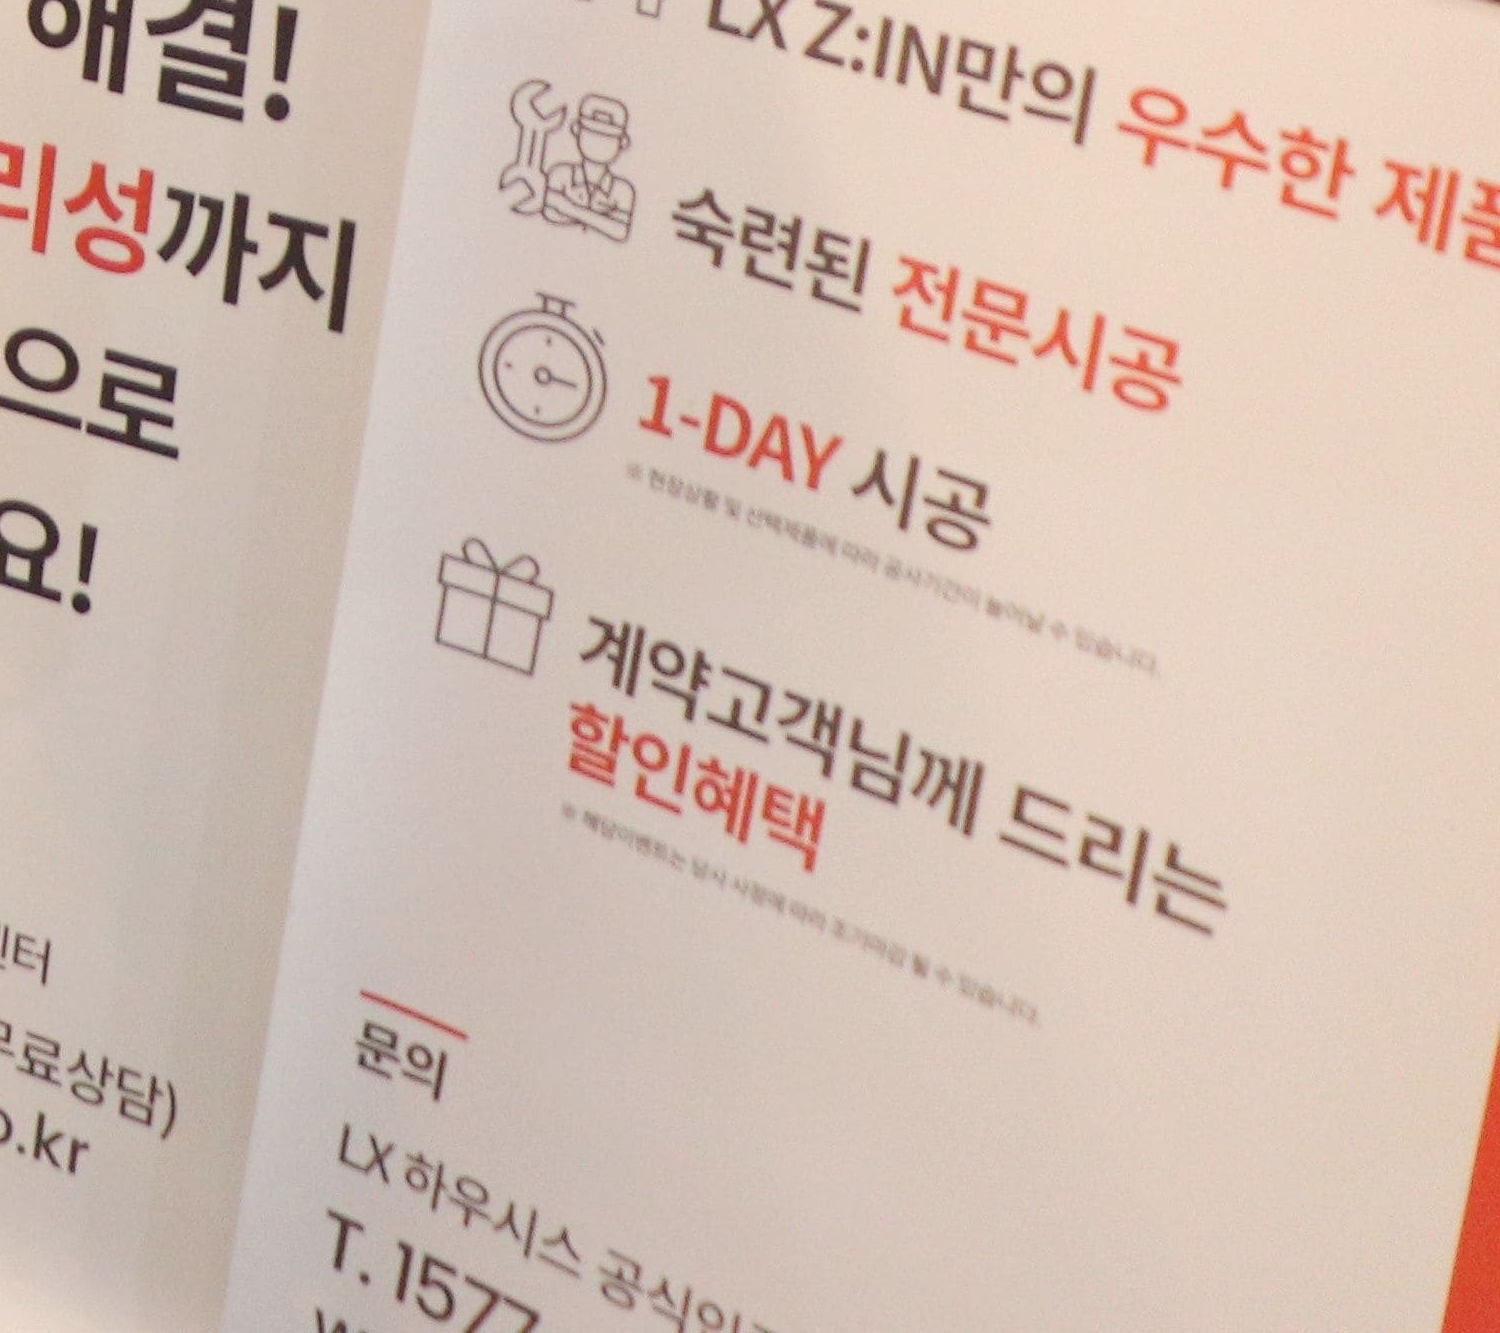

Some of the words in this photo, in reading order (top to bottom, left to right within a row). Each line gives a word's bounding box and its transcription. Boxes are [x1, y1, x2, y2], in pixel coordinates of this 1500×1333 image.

[1116, 86, 1356, 222] 우수한
[670, 188, 872, 316] 숙련된
[892, 253, 1184, 416] 전문시공
[638, 374, 844, 492] 1-DAY
[851, 447, 991, 552] 시공
[568, 701, 827, 874] 할인혜택
[580, 615, 985, 838] 계약고객님께
[998, 783, 1227, 937] 드리는
[352, 1019, 450, 1103] 문의
[326, 1208, 370, 1286] T.
[338, 1122, 395, 1185] LX
[404, 1149, 582, 1281] 하우시스
